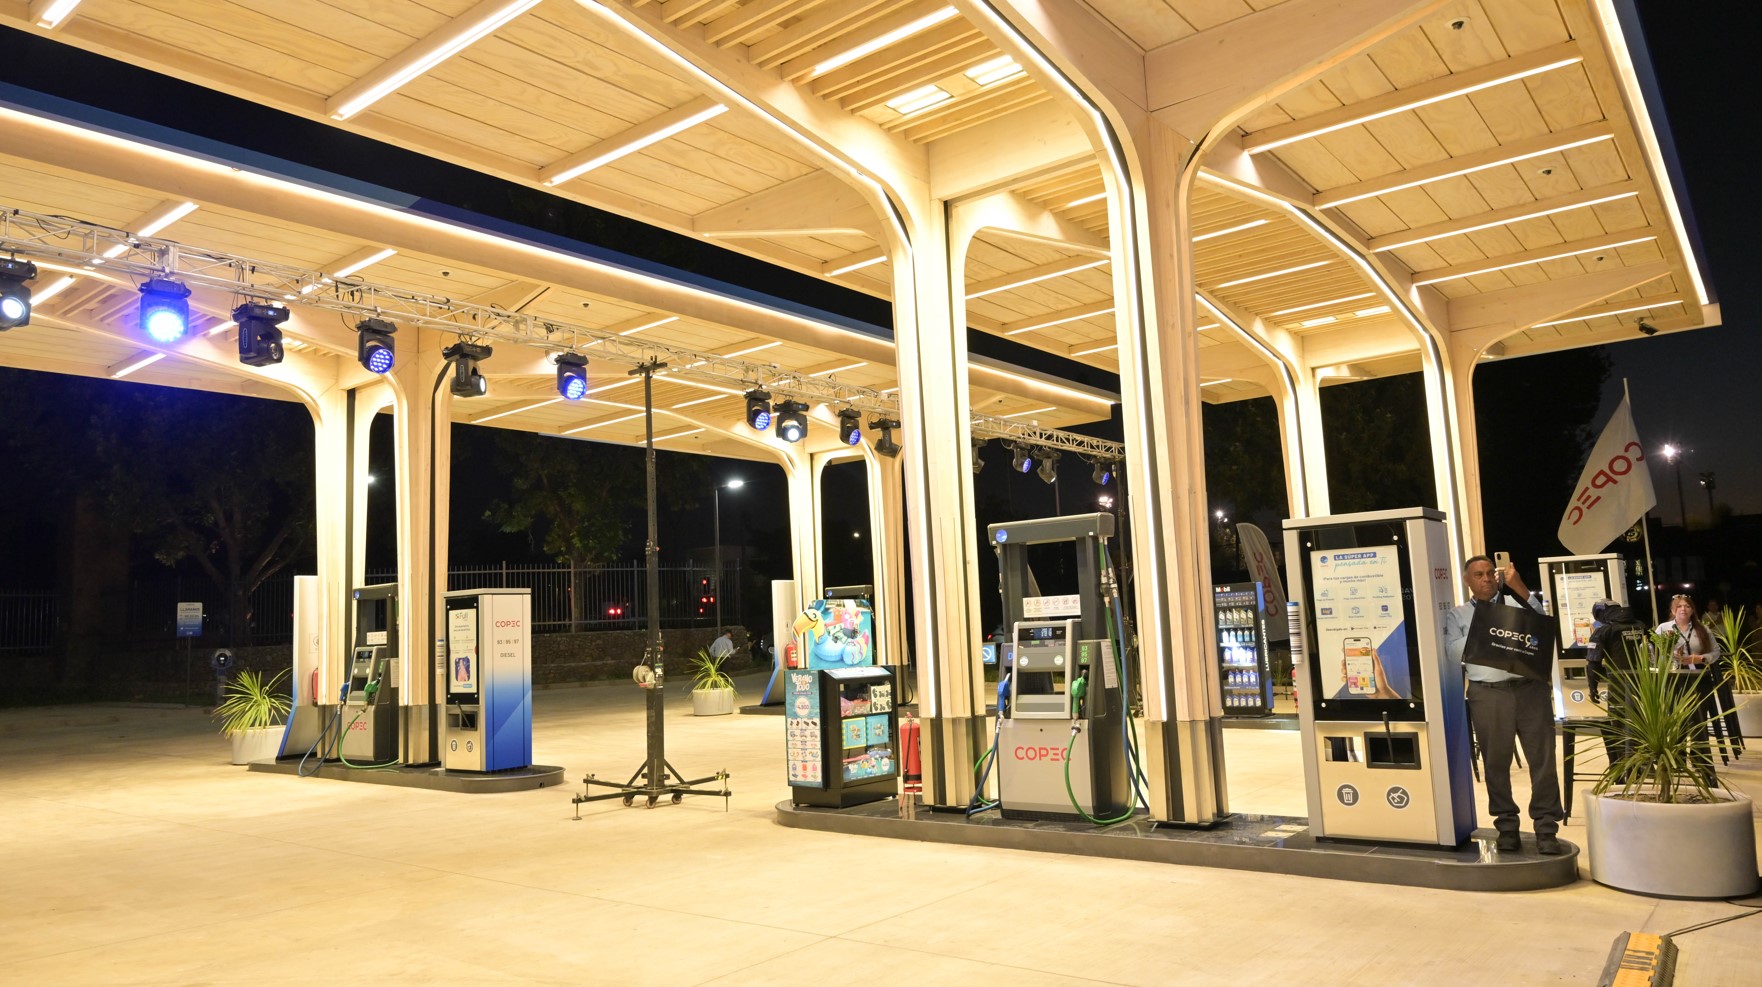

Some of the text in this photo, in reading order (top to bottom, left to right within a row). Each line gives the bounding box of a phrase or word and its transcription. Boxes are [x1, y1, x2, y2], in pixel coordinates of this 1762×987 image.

[1490, 628, 1524, 642] COPEC
[1261, 619, 1270, 671] LUBRICANTES
[791, 672, 813, 683] VERANO
[1014, 746, 1072, 761] COPEC
